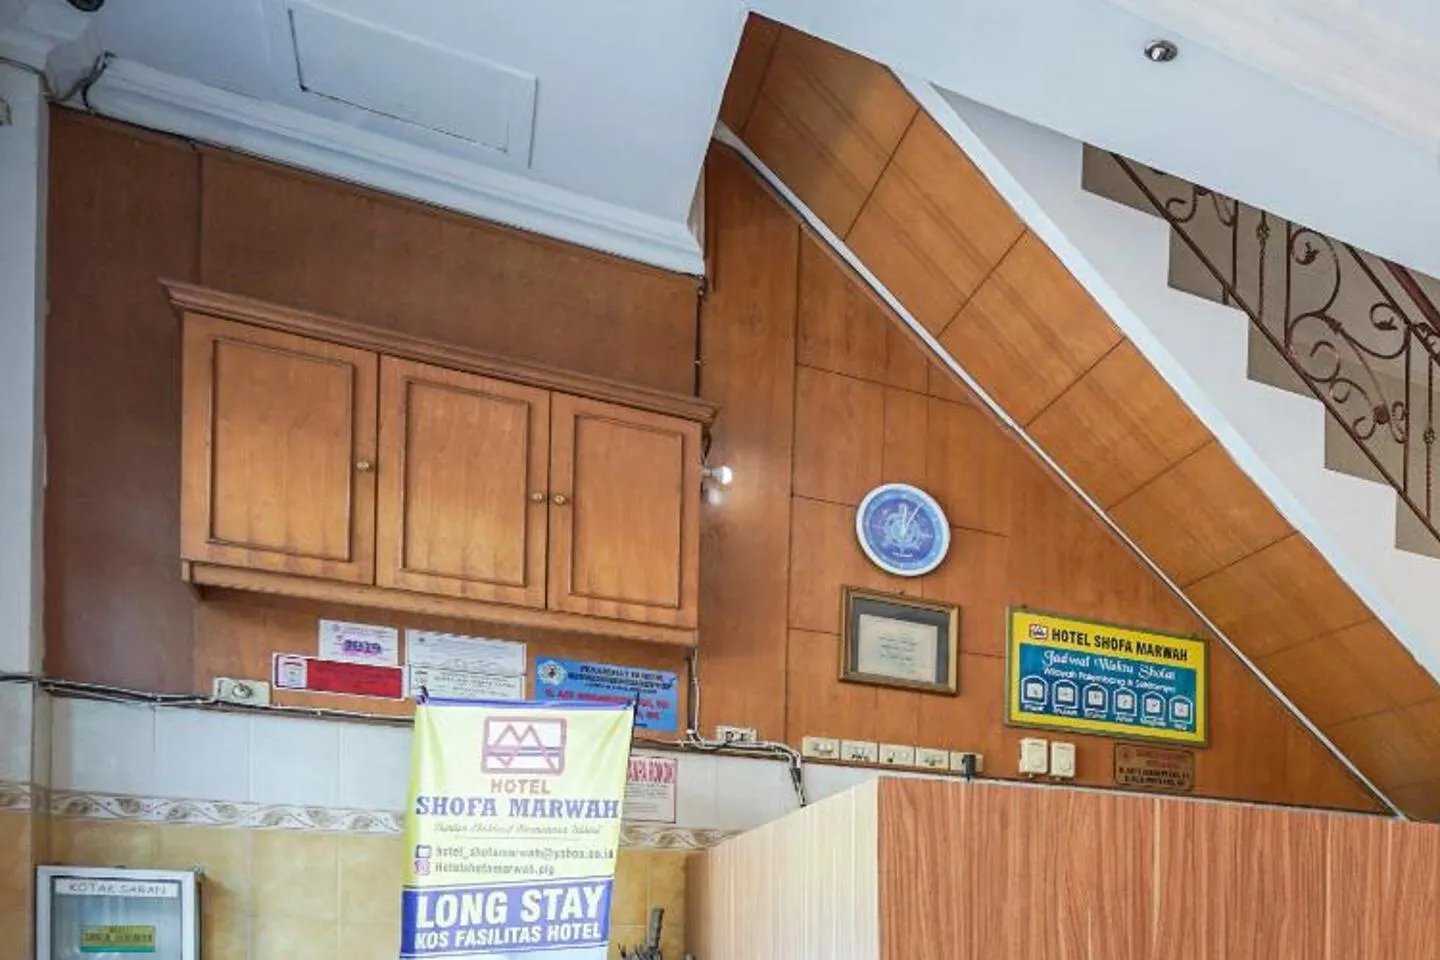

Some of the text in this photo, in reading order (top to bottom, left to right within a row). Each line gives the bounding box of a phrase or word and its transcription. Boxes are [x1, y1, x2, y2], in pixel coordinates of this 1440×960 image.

[343, 639, 382, 653] 2019
[1051, 629, 1188, 661] HOTEL SHOFA MARWAH
[1042, 650, 1090, 668] Jadwal
[1094, 657, 1134, 673] Waktu
[490, 779, 551, 795] HOTEL
[416, 796, 498, 817] SHOFA
[508, 799, 620, 820] MARWAH
[416, 884, 606, 929] LONG STAY
[414, 922, 602, 949] KOS FASILITAS HOTEL
